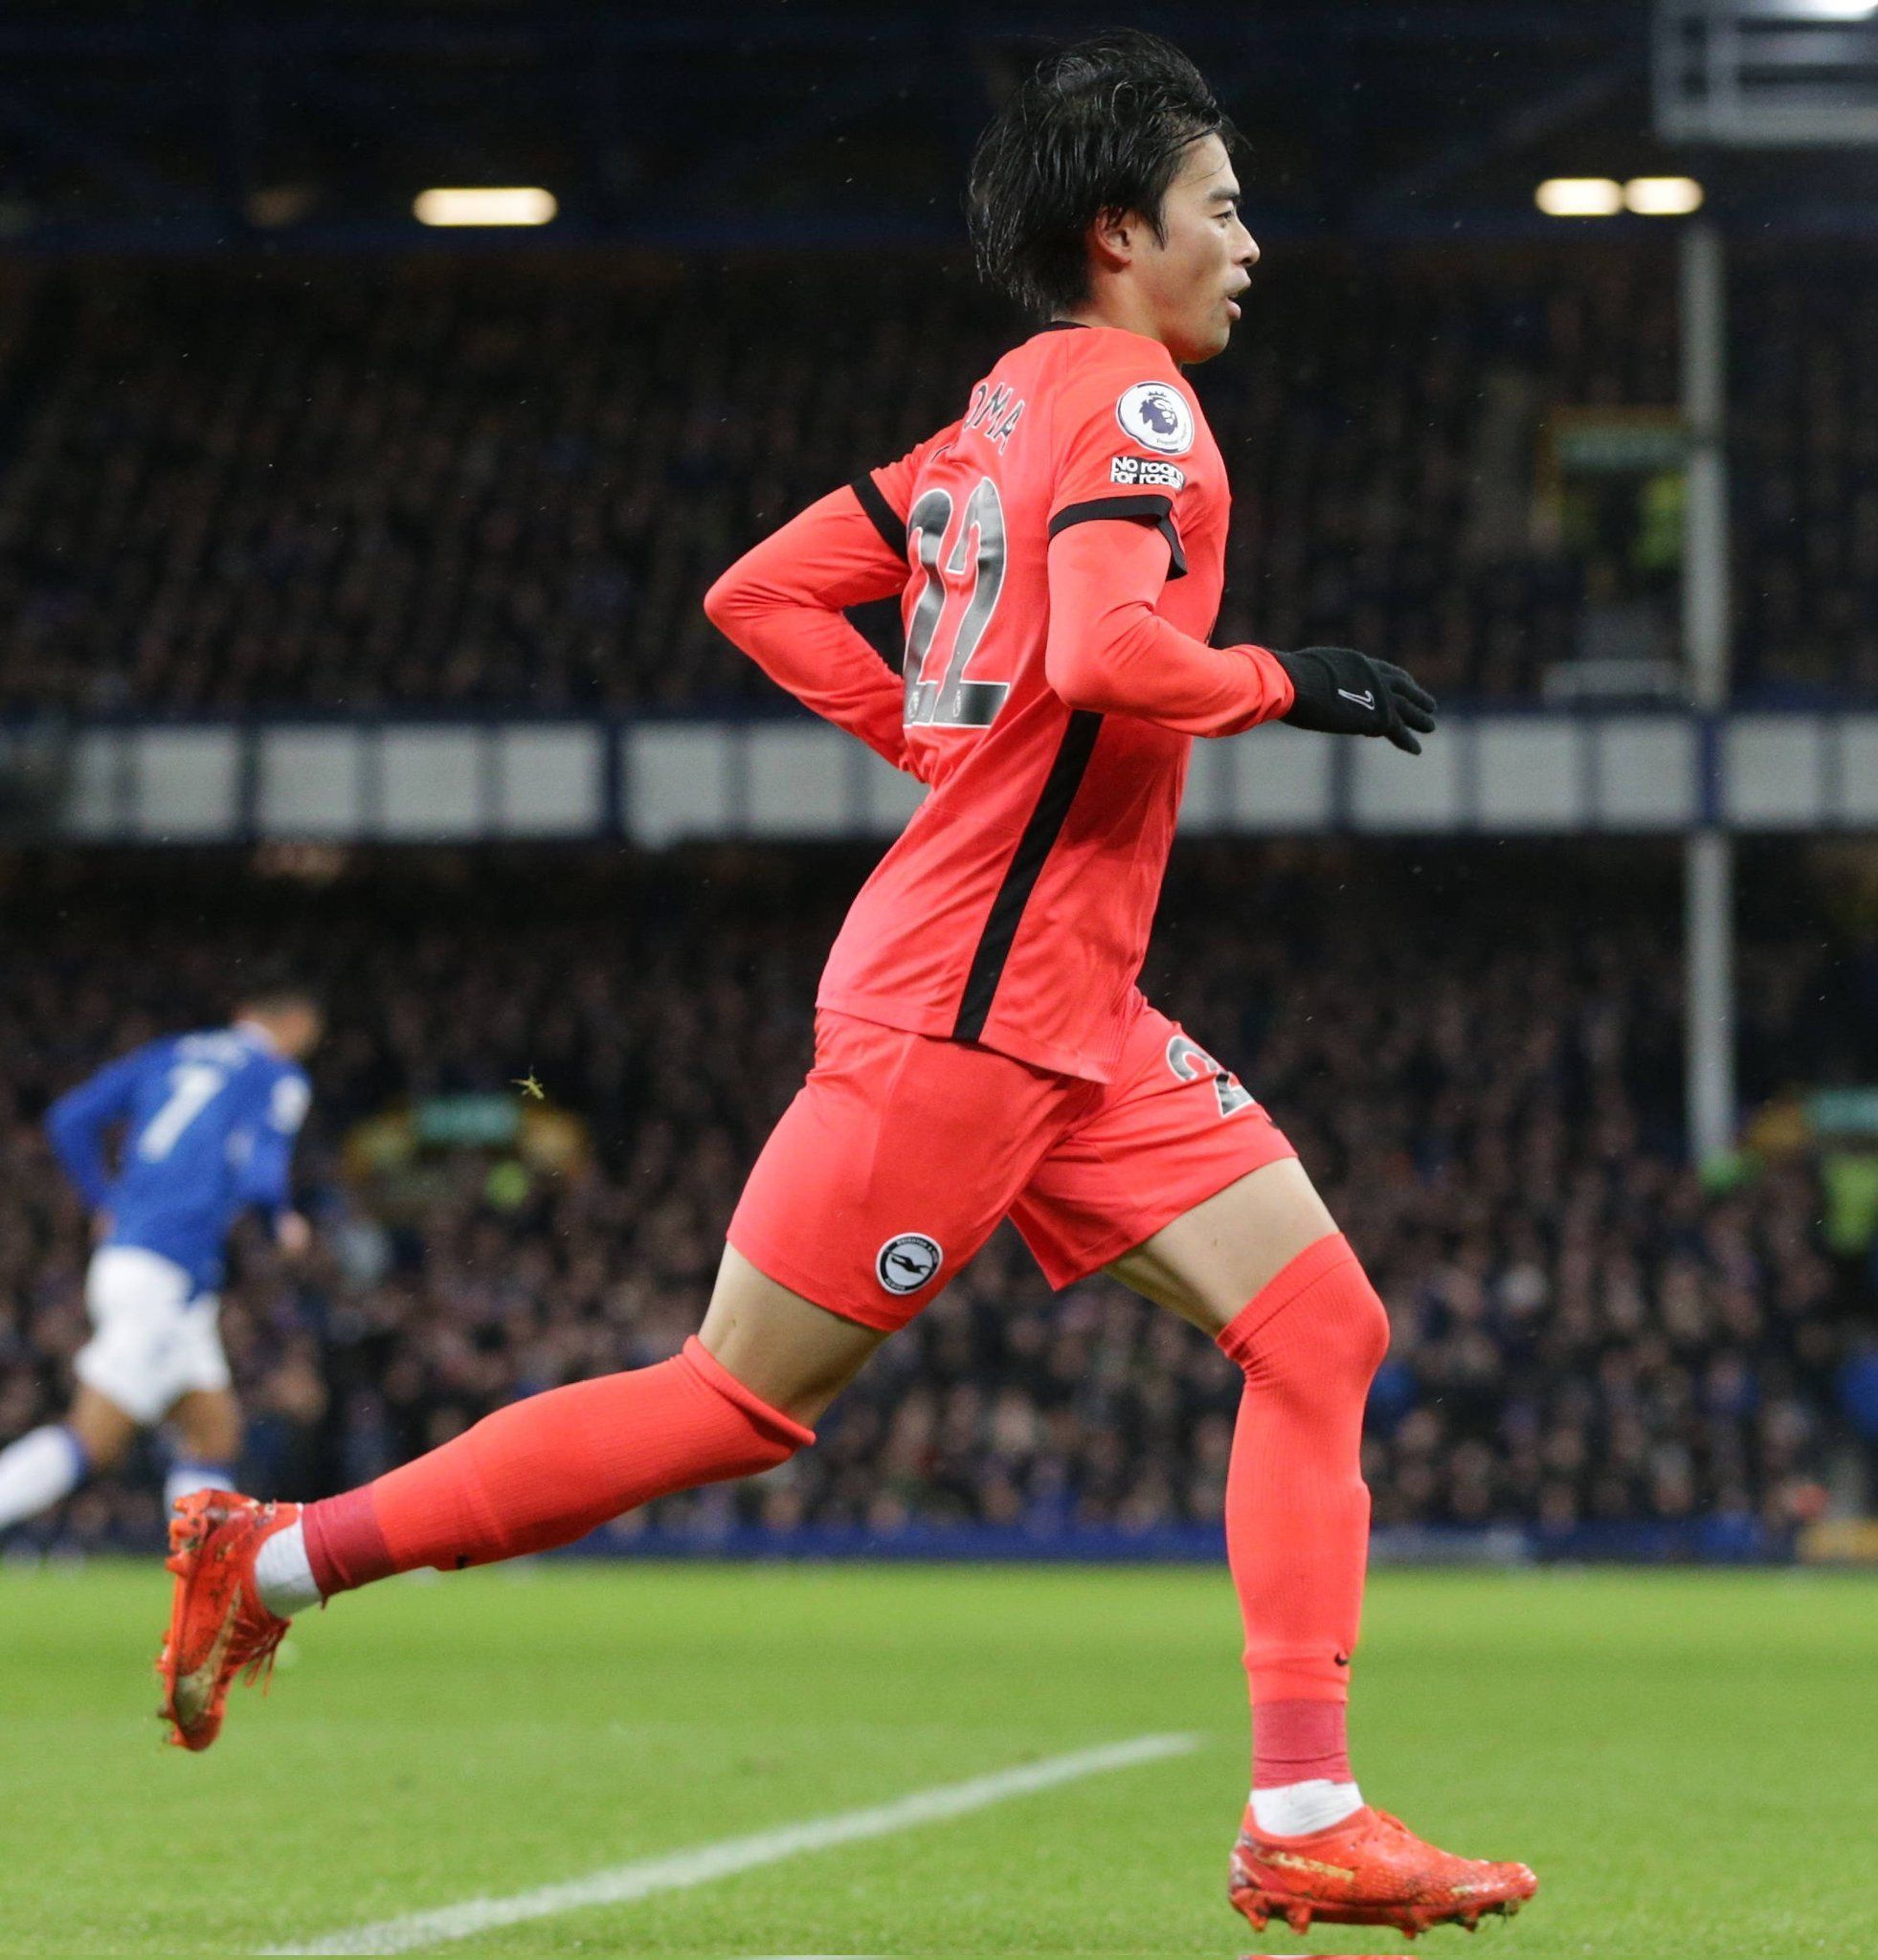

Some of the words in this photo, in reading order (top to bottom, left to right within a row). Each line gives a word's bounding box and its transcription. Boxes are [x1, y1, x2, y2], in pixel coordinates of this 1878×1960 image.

[1111, 457, 1138, 472] No
[1109, 471, 1138, 484] for
[903, 476, 1011, 728] 22
